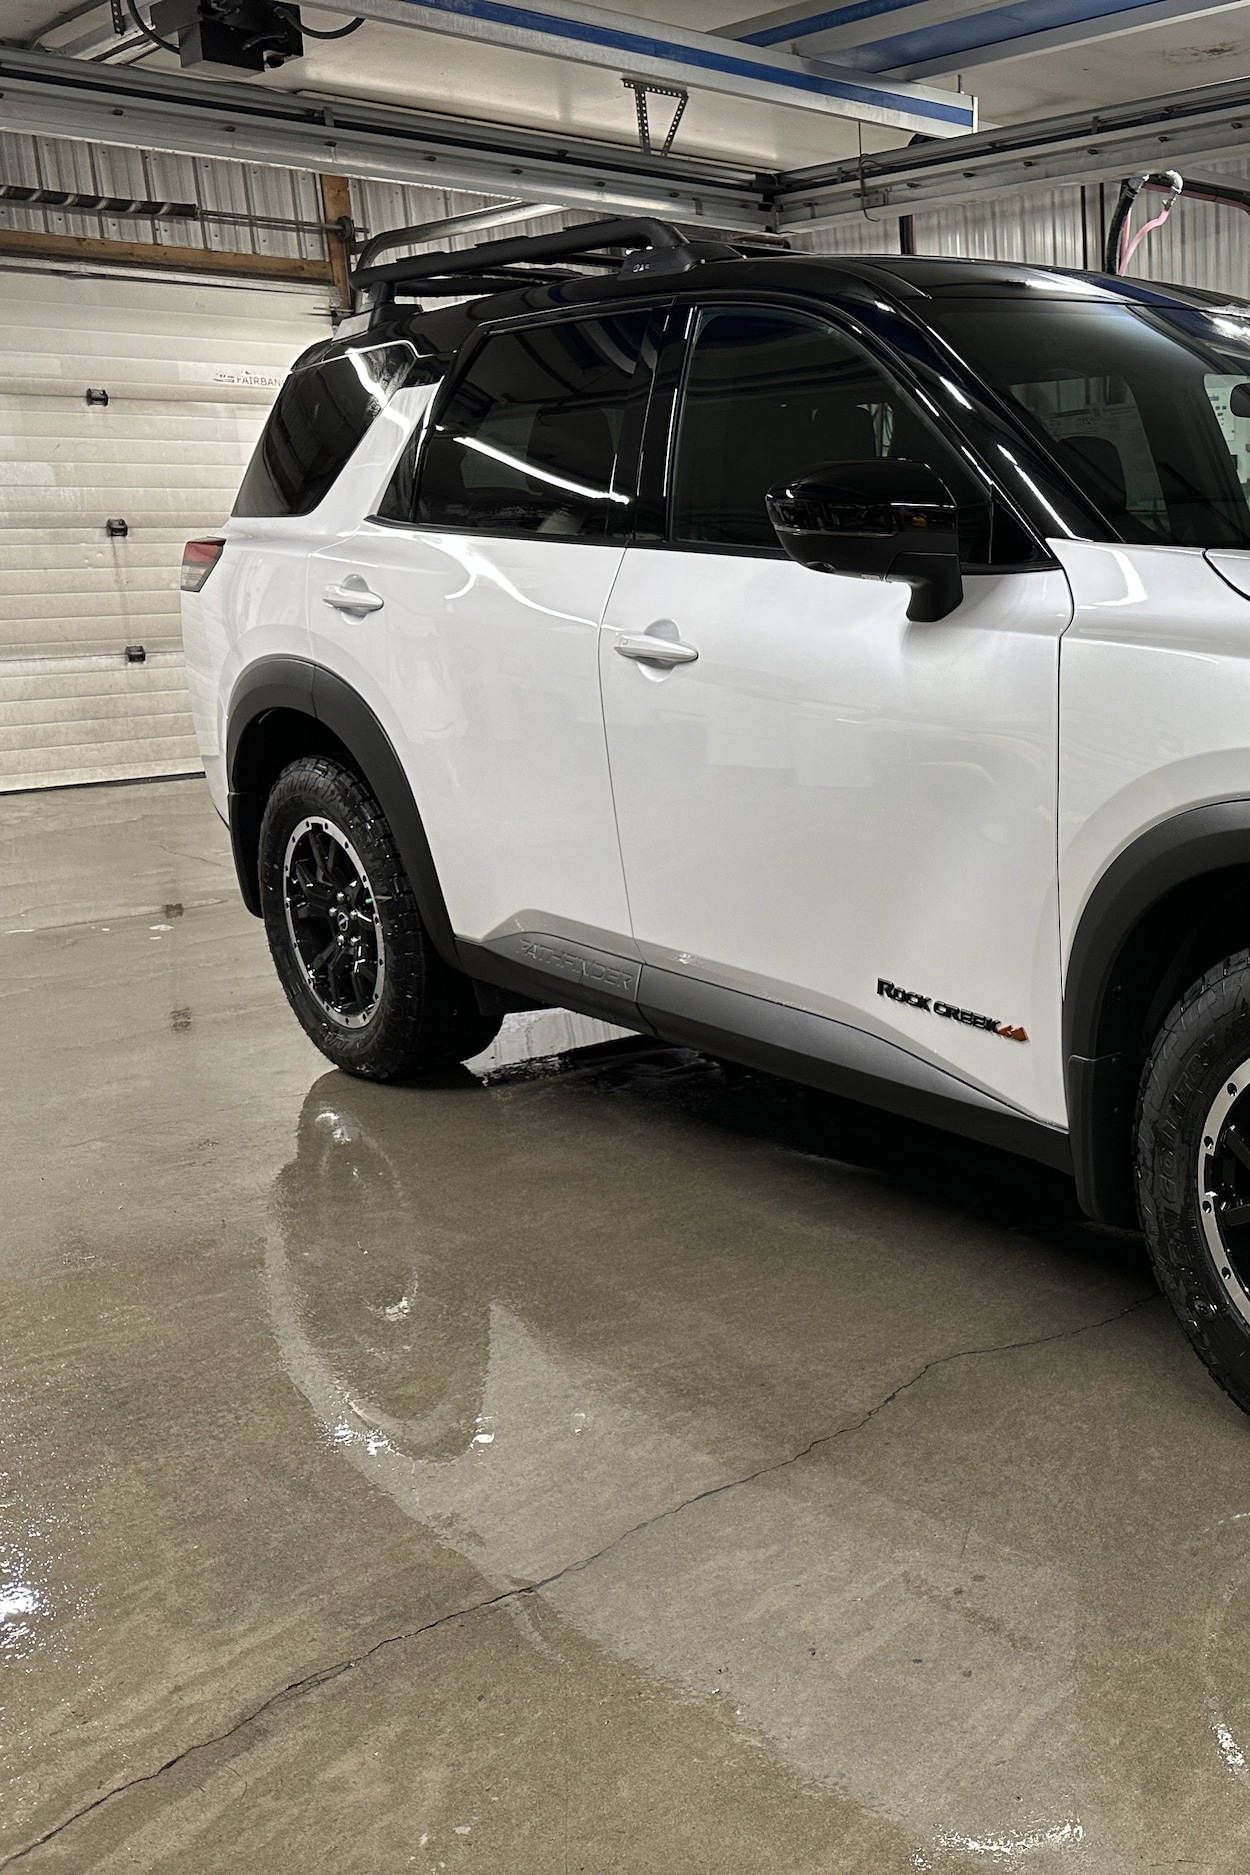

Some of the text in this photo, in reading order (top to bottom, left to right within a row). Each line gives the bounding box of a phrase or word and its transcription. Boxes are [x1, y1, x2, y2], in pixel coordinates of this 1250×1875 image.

[237, 376, 284, 387] FAIRBAN
[876, 977, 1001, 1034] ROCK CREEK
